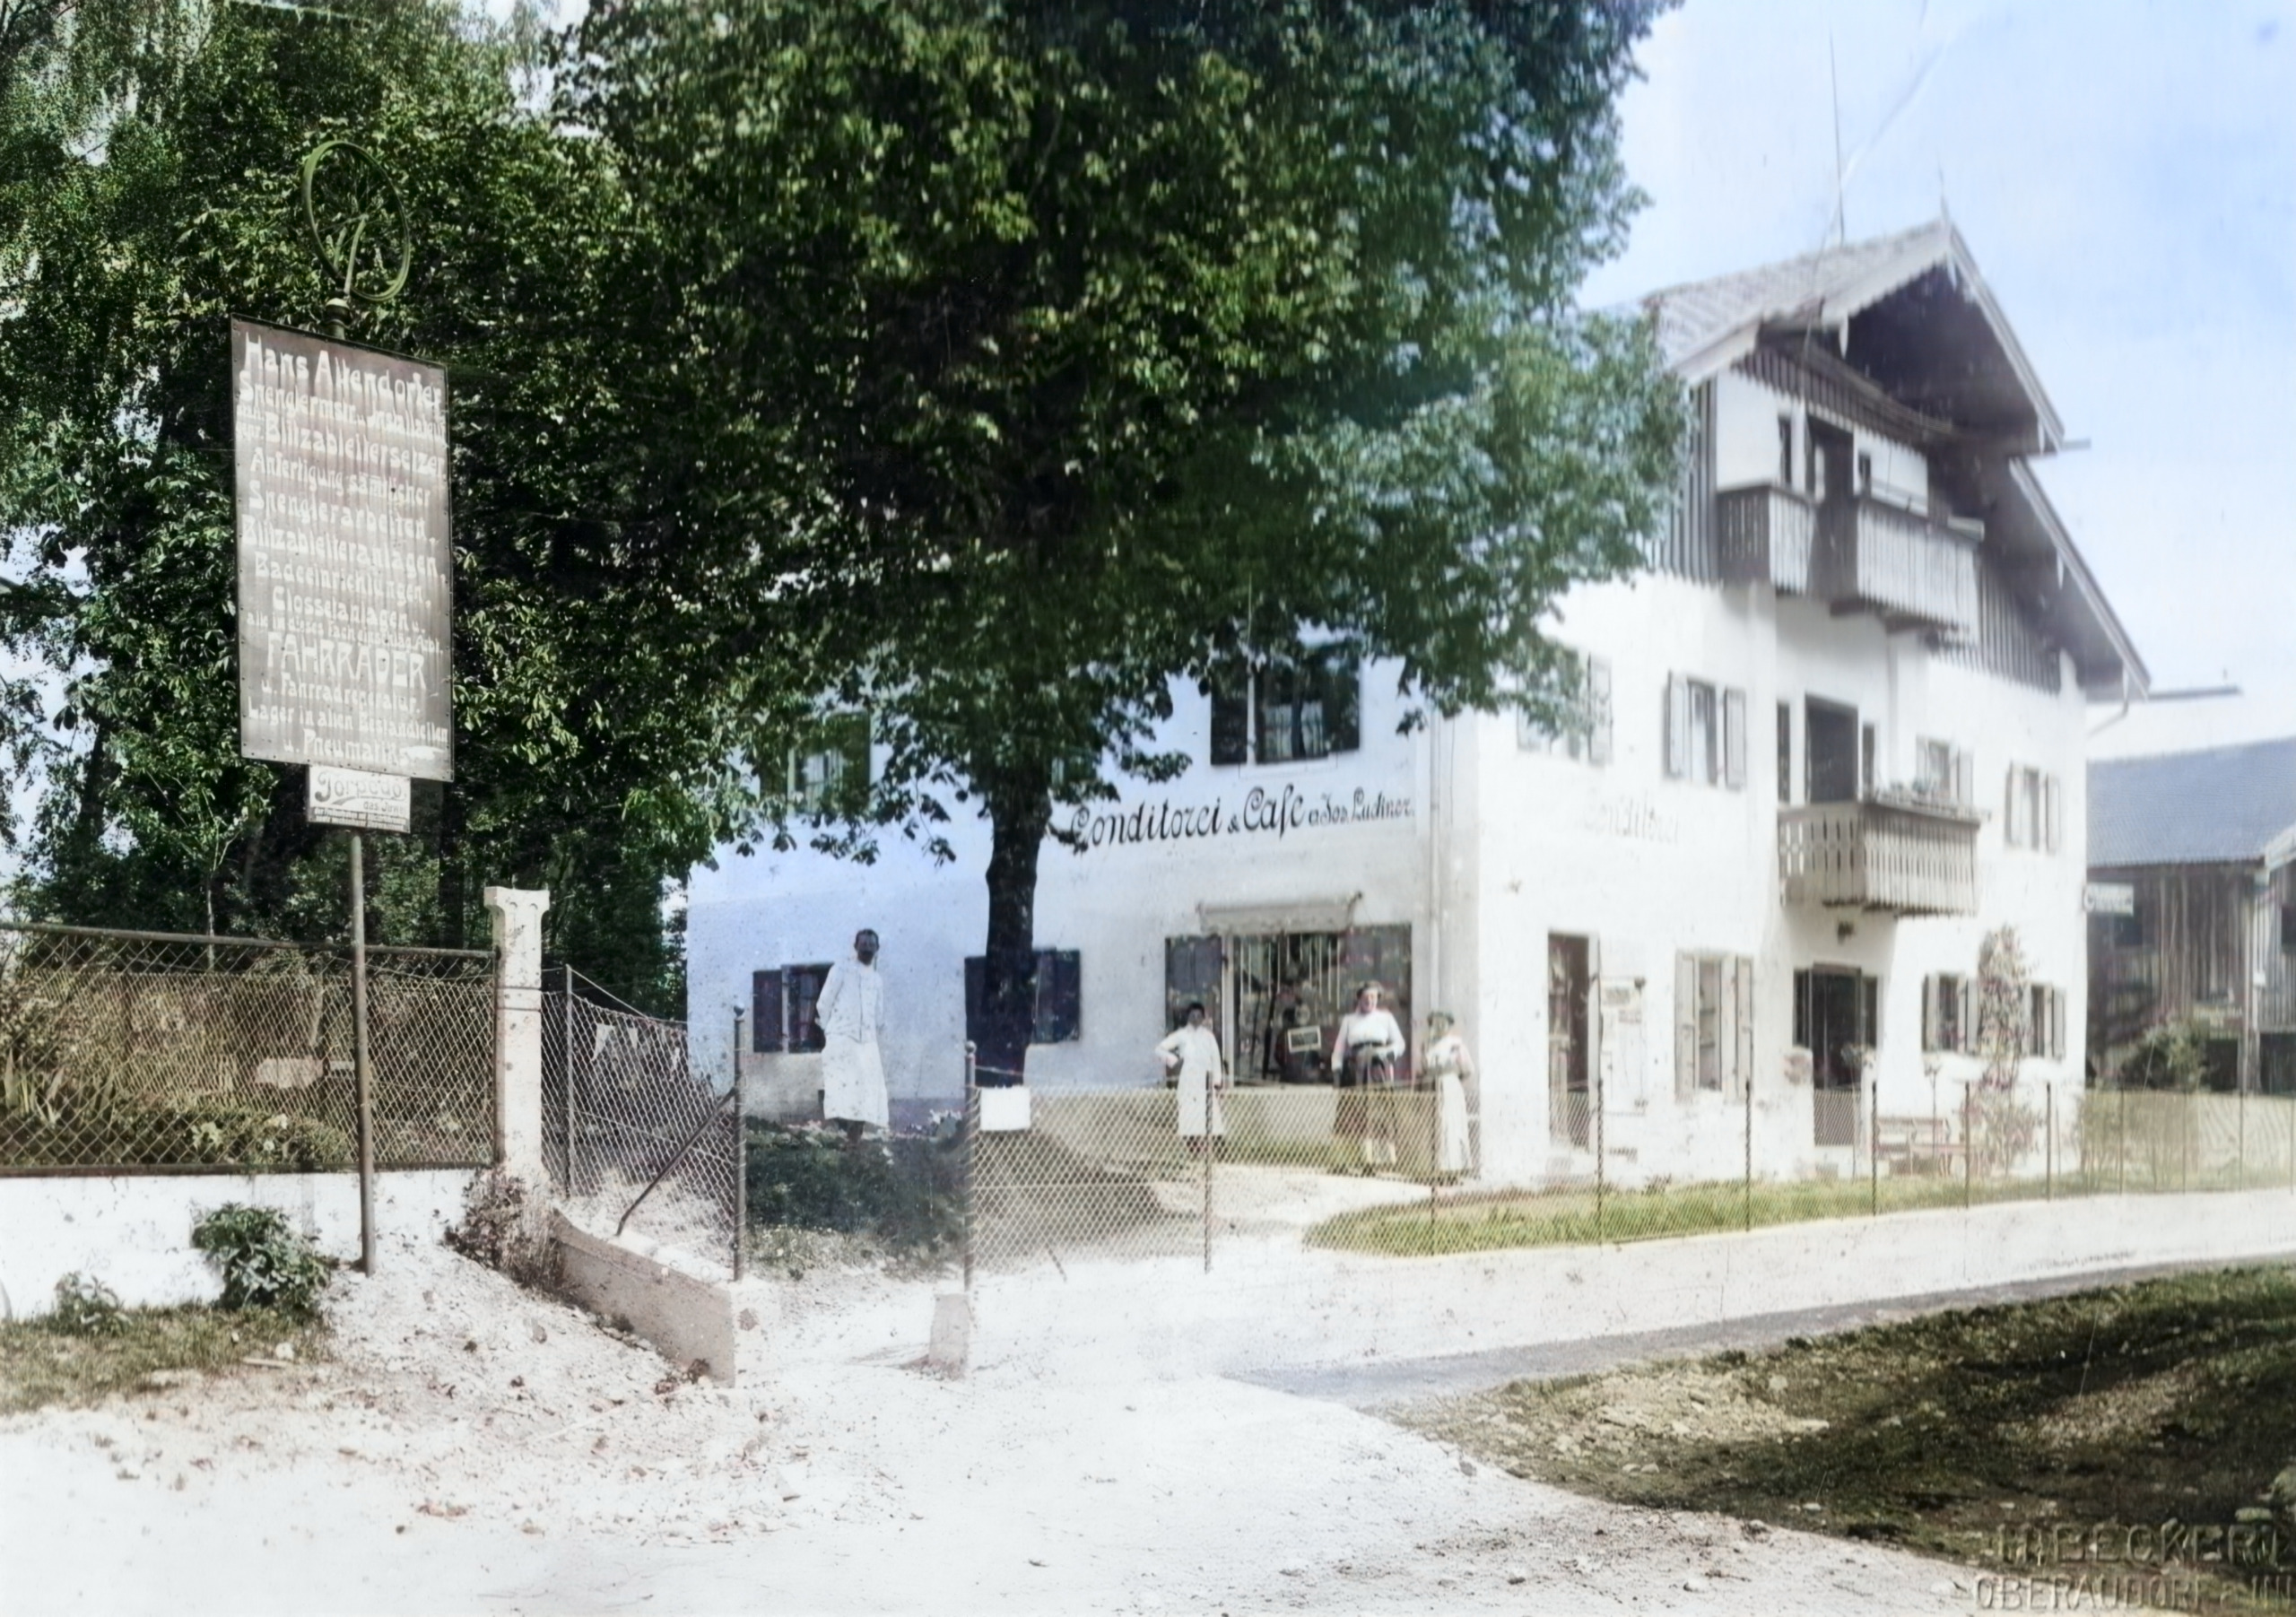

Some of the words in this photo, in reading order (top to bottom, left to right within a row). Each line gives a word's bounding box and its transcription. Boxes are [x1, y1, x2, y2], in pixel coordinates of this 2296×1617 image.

[242, 330, 309, 380] Hans
[266, 630, 426, 691] FAHRRÄDER
[248, 695, 294, 726] Lager
[298, 705, 314, 726] in
